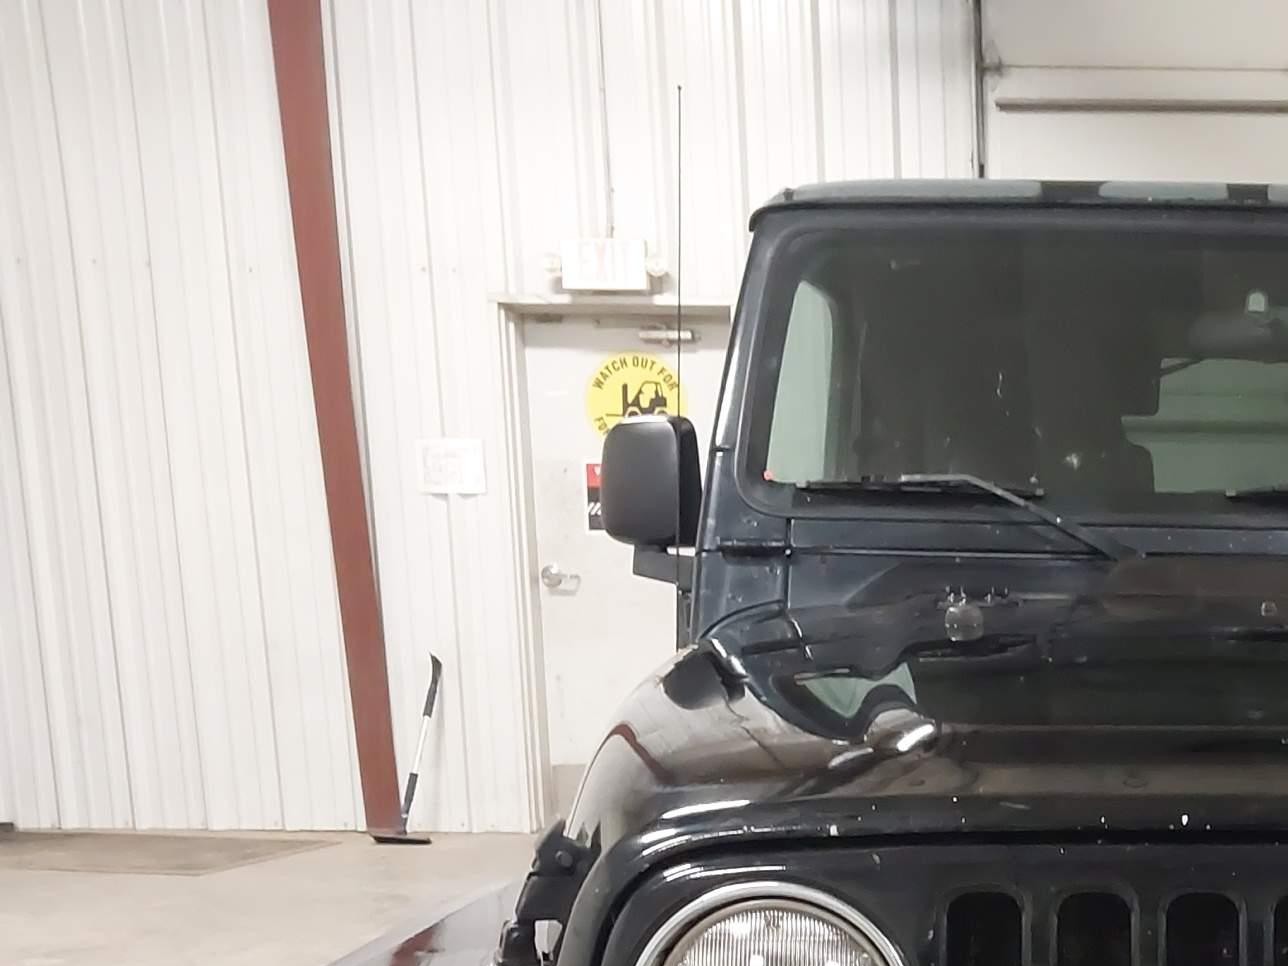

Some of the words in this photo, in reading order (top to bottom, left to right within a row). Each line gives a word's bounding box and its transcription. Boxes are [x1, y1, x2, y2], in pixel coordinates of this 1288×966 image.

[592, 357, 628, 390] WATCH
[632, 355, 657, 371] OUT
[657, 366, 679, 391] FOR
